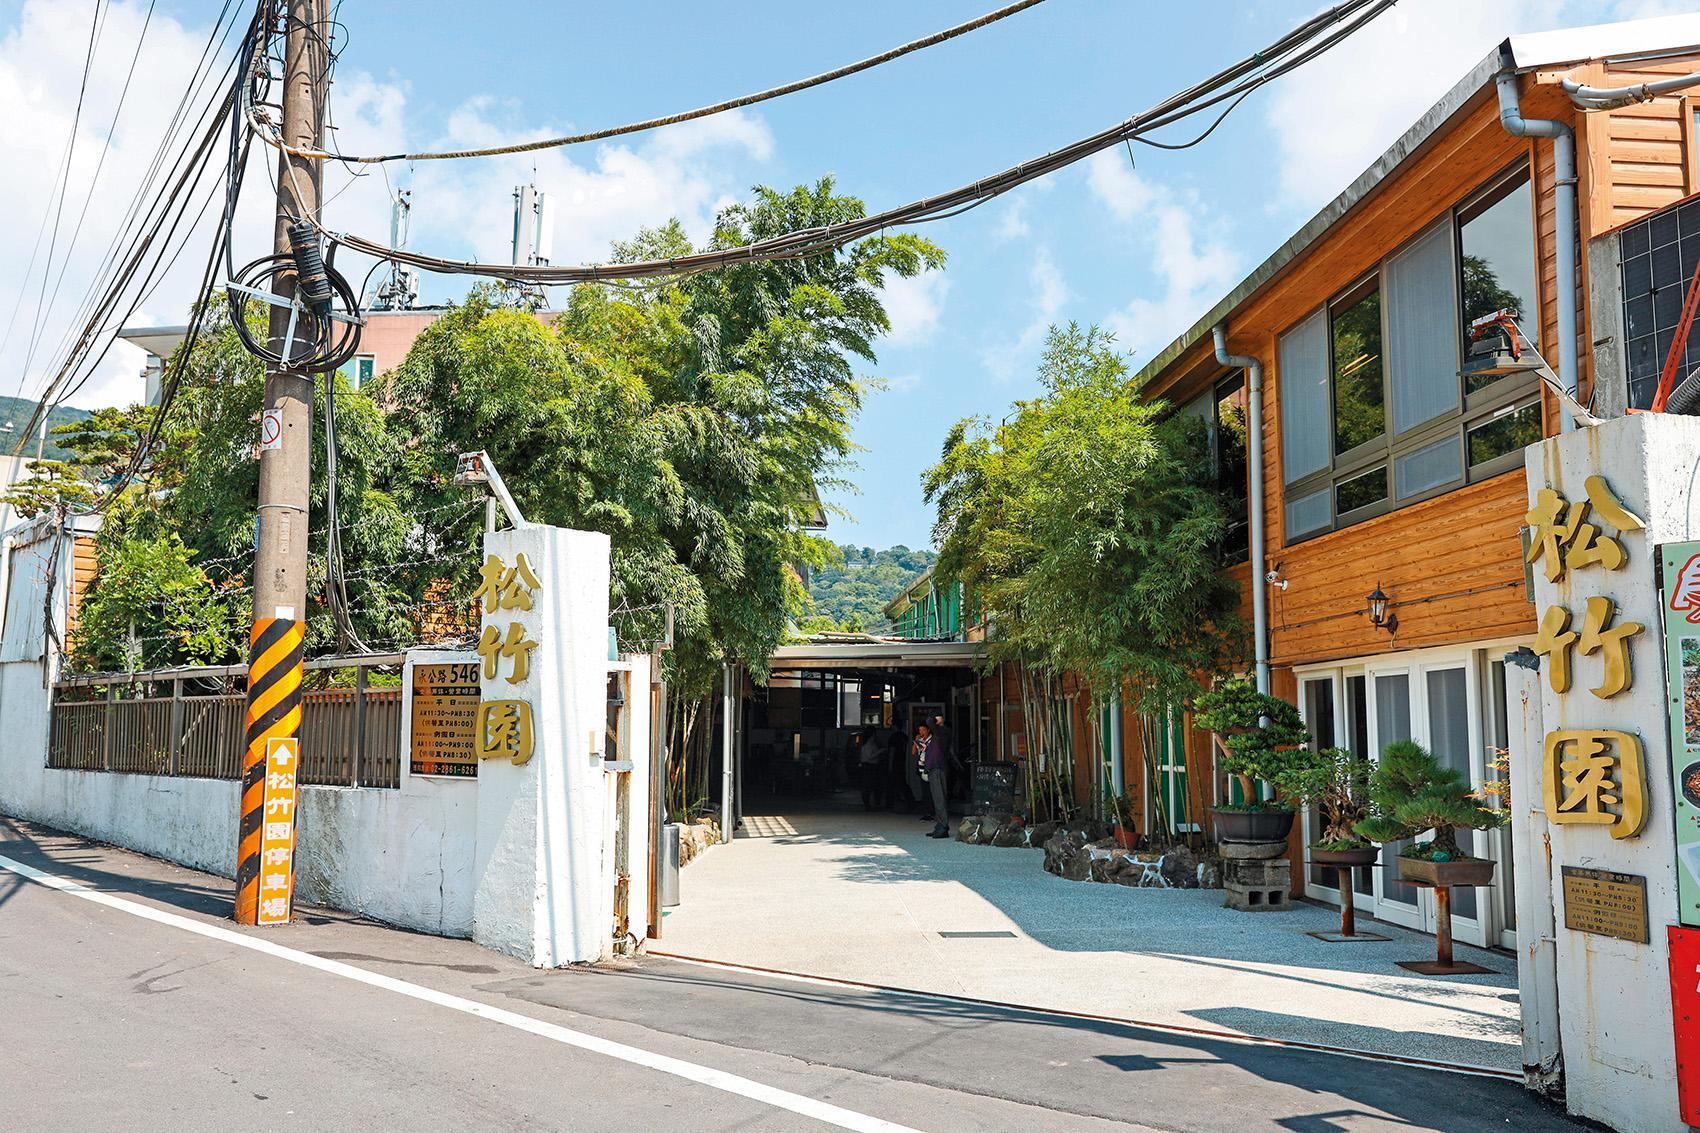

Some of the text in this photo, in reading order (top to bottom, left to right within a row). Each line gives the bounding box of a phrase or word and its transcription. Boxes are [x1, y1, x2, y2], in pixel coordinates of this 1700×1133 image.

[450, 664, 479, 684] 546
[473, 552, 543, 766] 松竹園
[1525, 475, 1649, 840] 松竹園
[262, 772, 294, 917] 松竹園停車場
